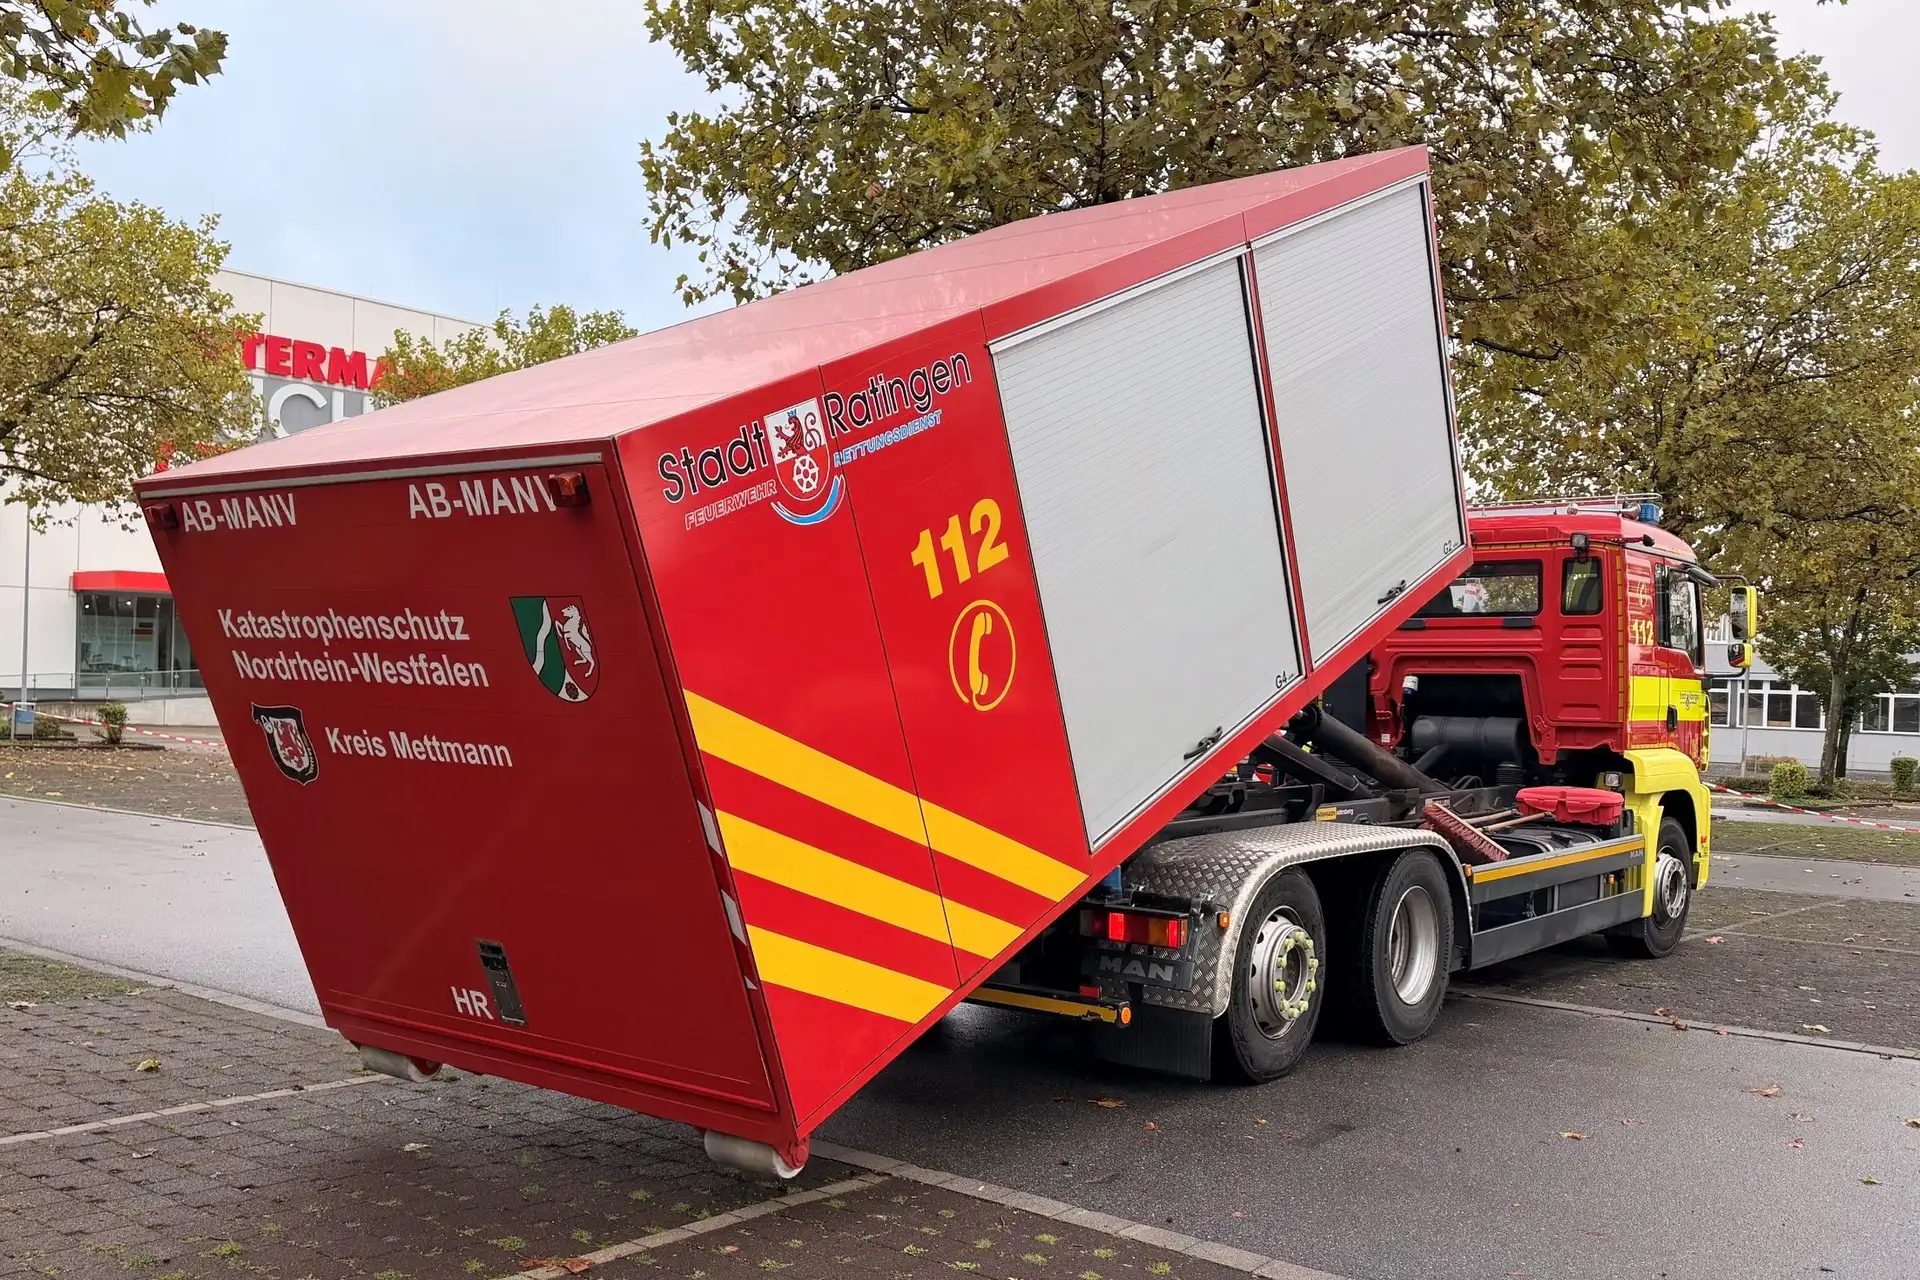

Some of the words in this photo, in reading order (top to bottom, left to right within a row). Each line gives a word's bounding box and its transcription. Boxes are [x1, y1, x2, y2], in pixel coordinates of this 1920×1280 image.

[658, 420, 769, 504] Stadt
[822, 352, 972, 438] Ratingen
[833, 409, 943, 467] RETTUNGSDIENST
[181, 492, 297, 533] AB-MANV
[684, 479, 777, 531] FEUERWEHR
[910, 498, 1010, 600] 112
[217, 607, 470, 645] Katastrophenschutz
[1632, 619, 1654, 646] 112
[232, 649, 490, 688] Nordrhein-Westfalen
[1275, 670, 1288, 689] G4
[324, 726, 388, 758] Kreis
[389, 731, 513, 767] Mettmann
[1100, 955, 1174, 982] MAN
[451, 986, 494, 1020] HR
